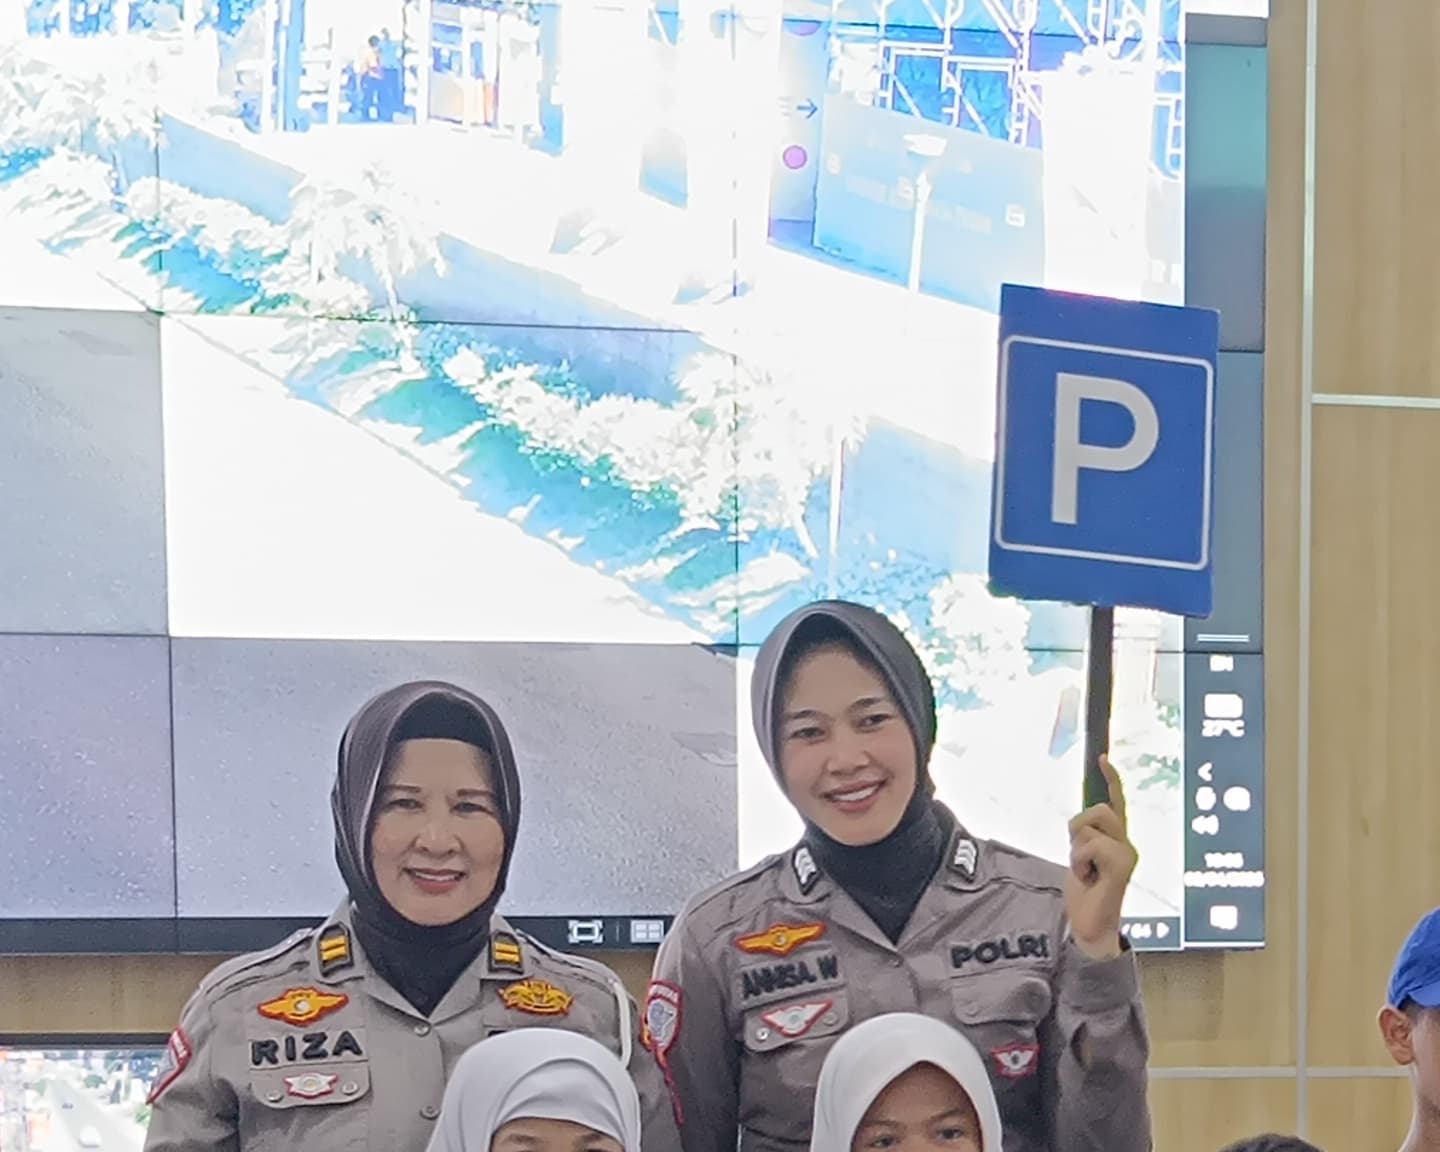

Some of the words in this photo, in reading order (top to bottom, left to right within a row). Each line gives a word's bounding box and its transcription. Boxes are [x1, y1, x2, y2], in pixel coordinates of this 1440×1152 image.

[1052, 372, 1159, 525] P
[951, 935, 1048, 968] POLRI
[250, 1031, 364, 1066] RIZA
